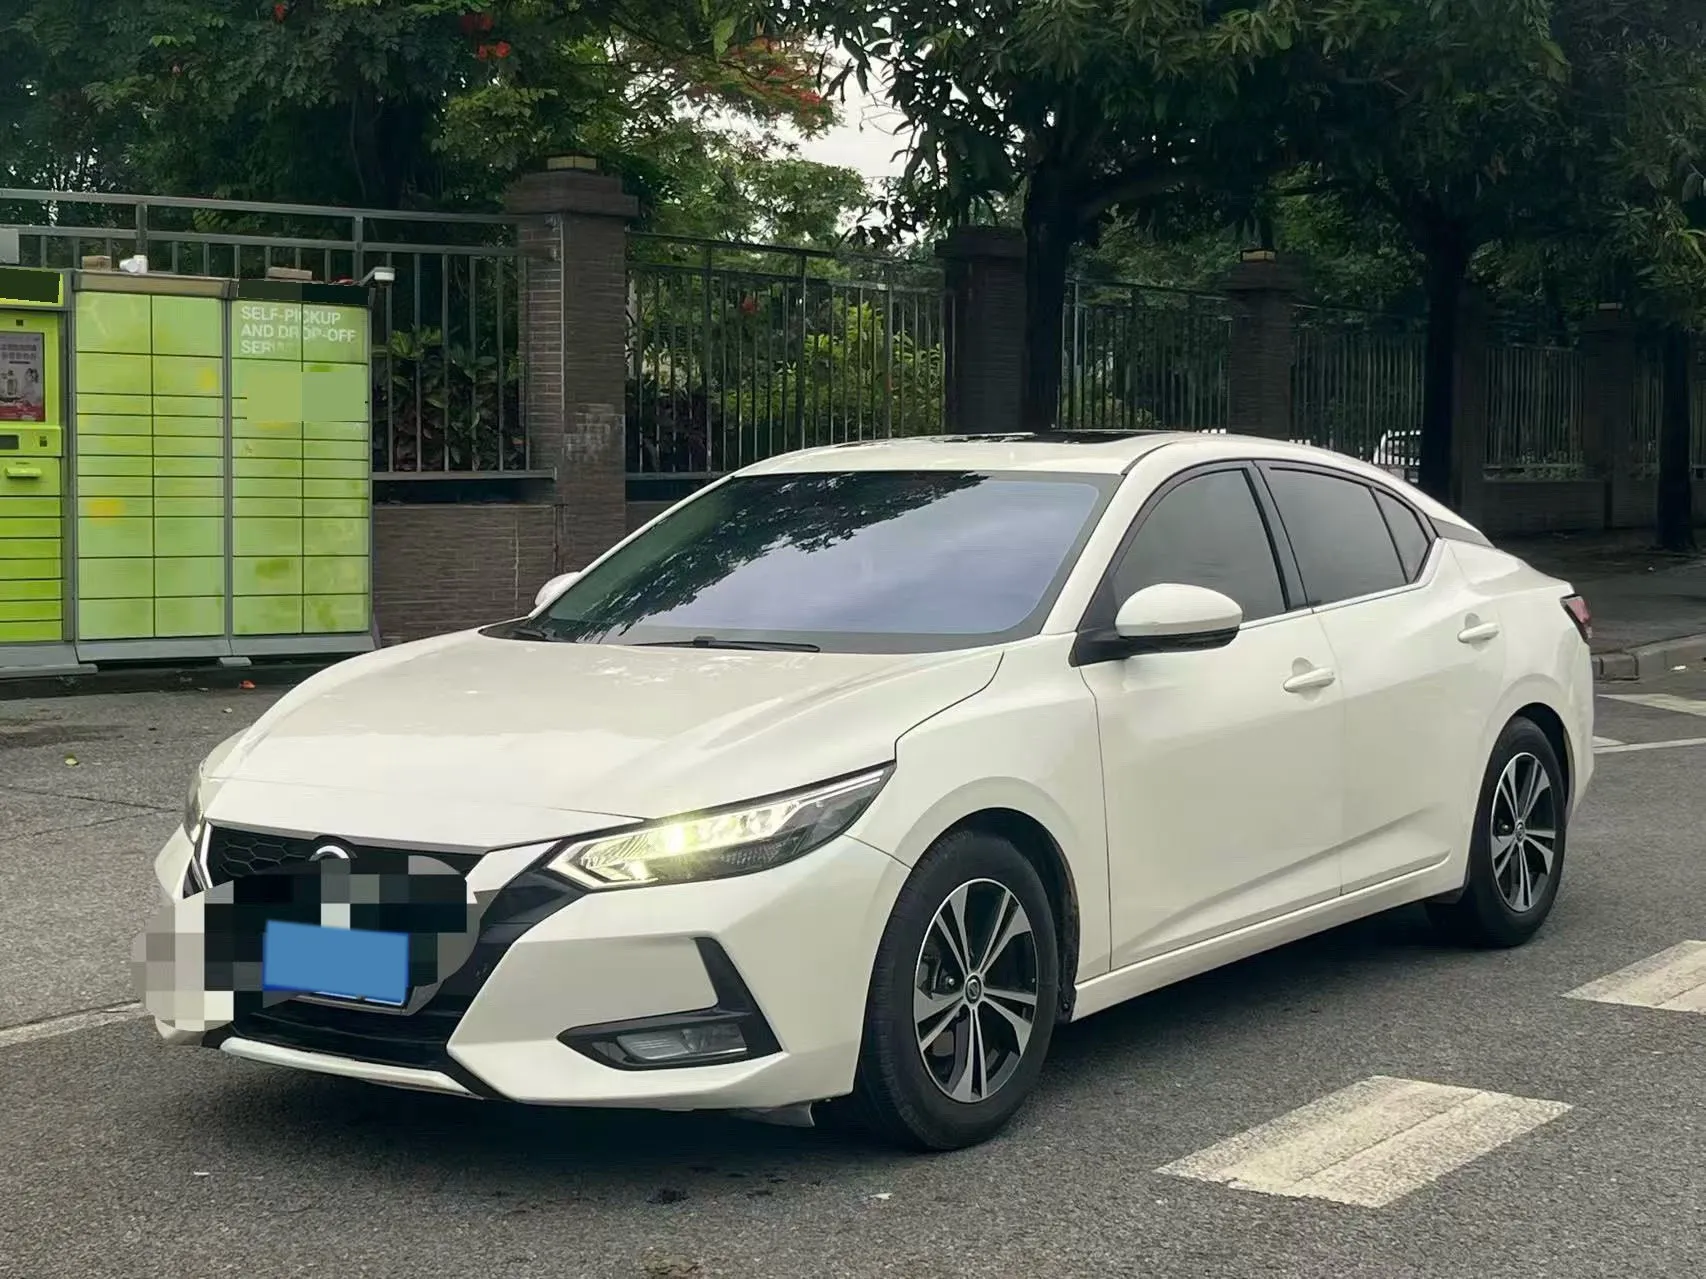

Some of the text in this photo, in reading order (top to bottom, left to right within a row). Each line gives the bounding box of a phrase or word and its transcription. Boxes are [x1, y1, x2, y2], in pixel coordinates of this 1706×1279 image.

[241, 306, 341, 325] SELF-PICKUP
[241, 324, 357, 342] AND DROP-OFF
